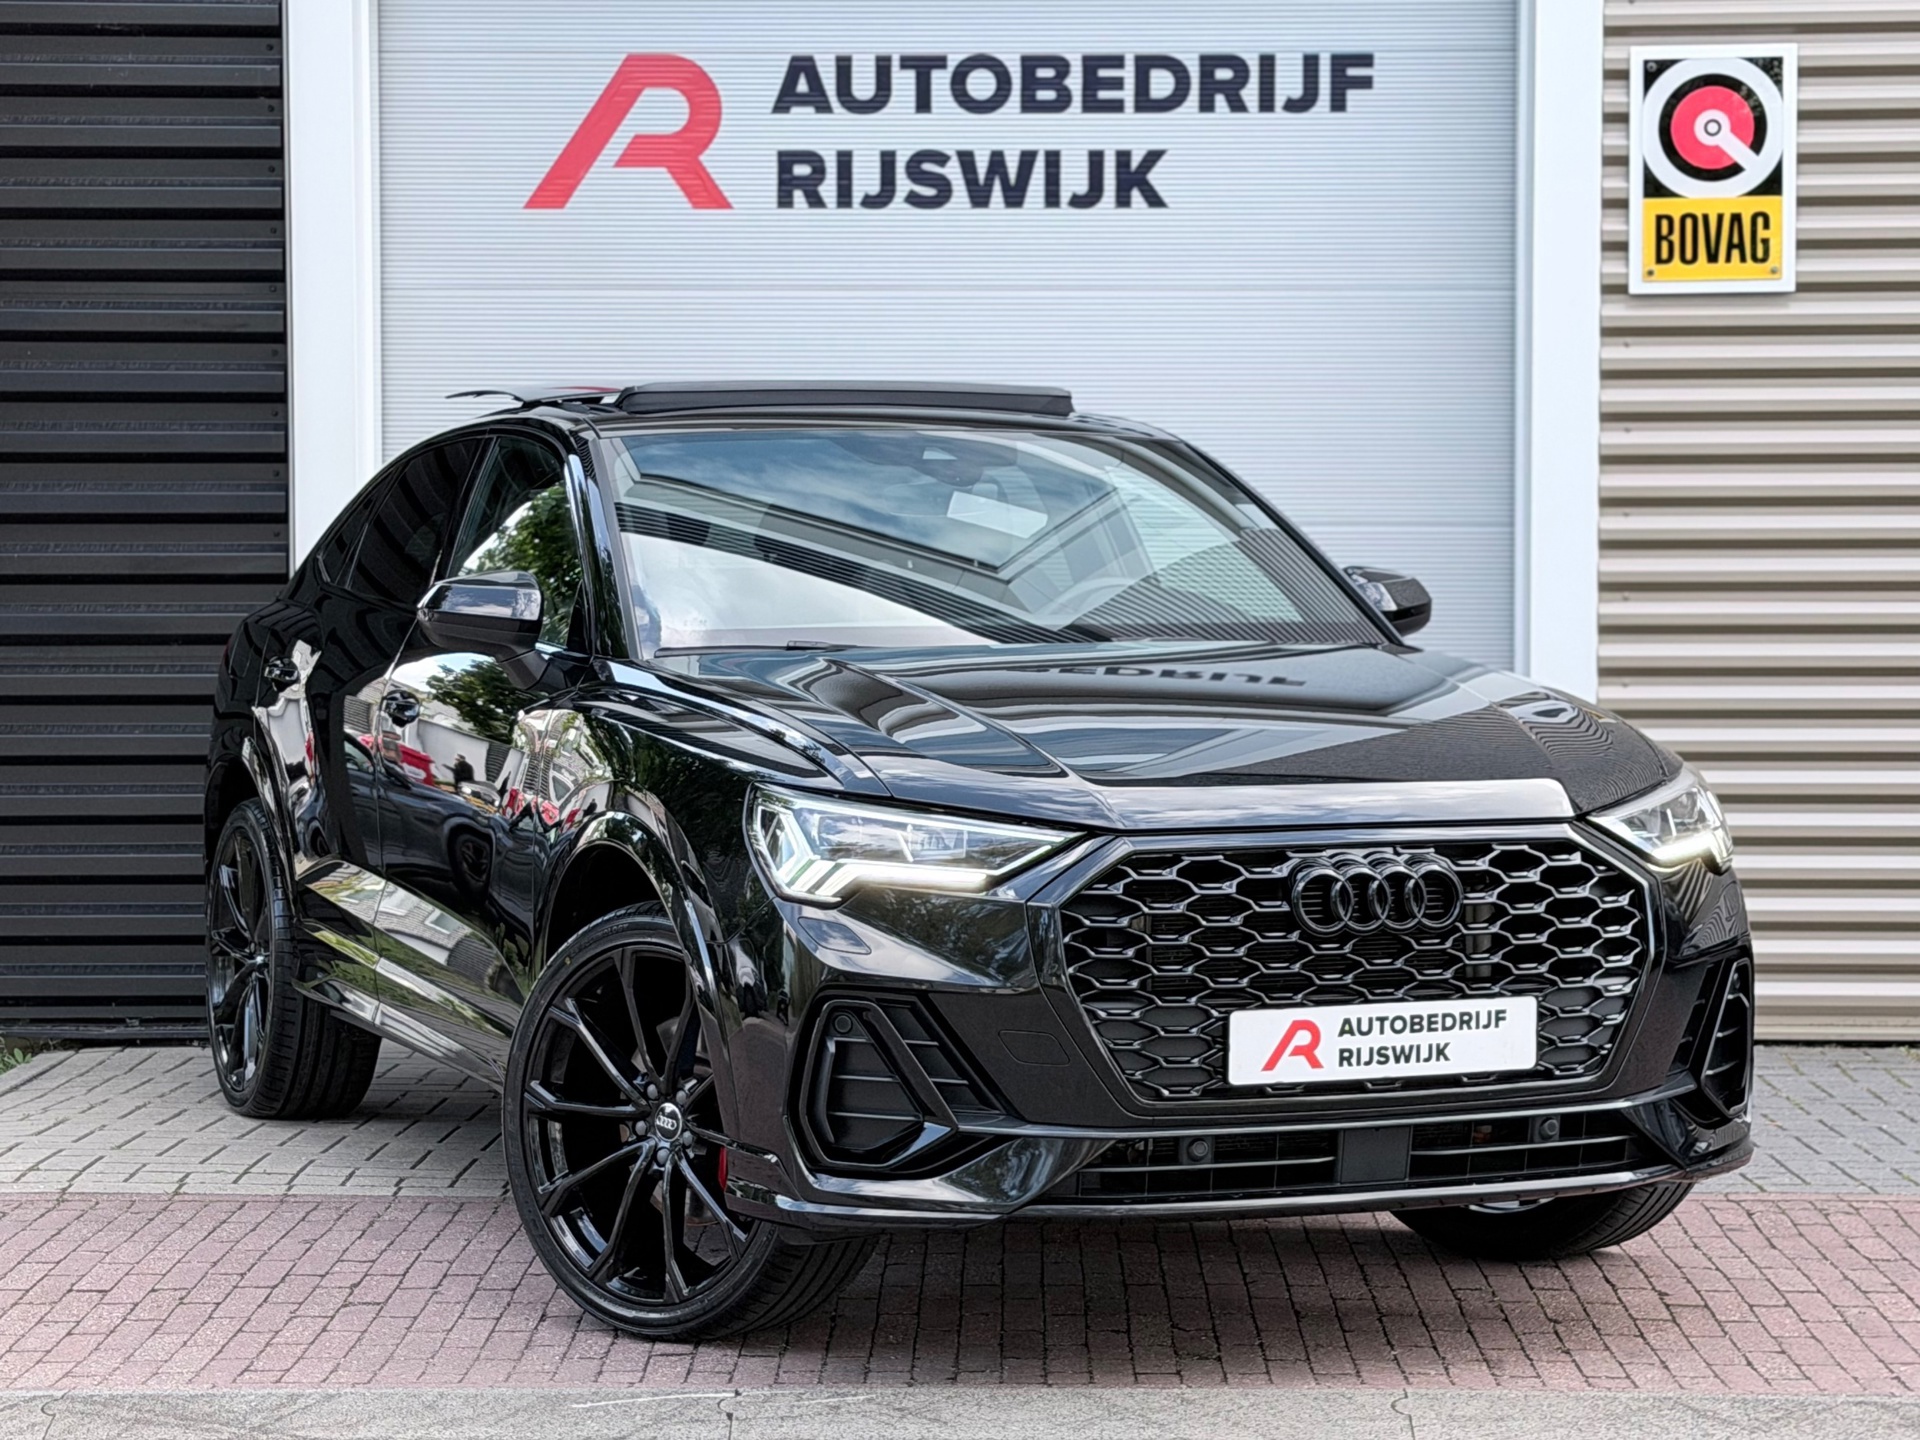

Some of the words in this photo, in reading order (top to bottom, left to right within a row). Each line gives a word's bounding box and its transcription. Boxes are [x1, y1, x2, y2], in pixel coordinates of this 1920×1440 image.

[772, 53, 1375, 114] AUTOBEDRIJF
[777, 150, 1169, 209] RIJSWIJK
[1654, 211, 1771, 266] BOVAG
[1338, 1009, 1507, 1038] AUTOBEDRIJF
[1338, 1042, 1451, 1067] RIJSWIJK
